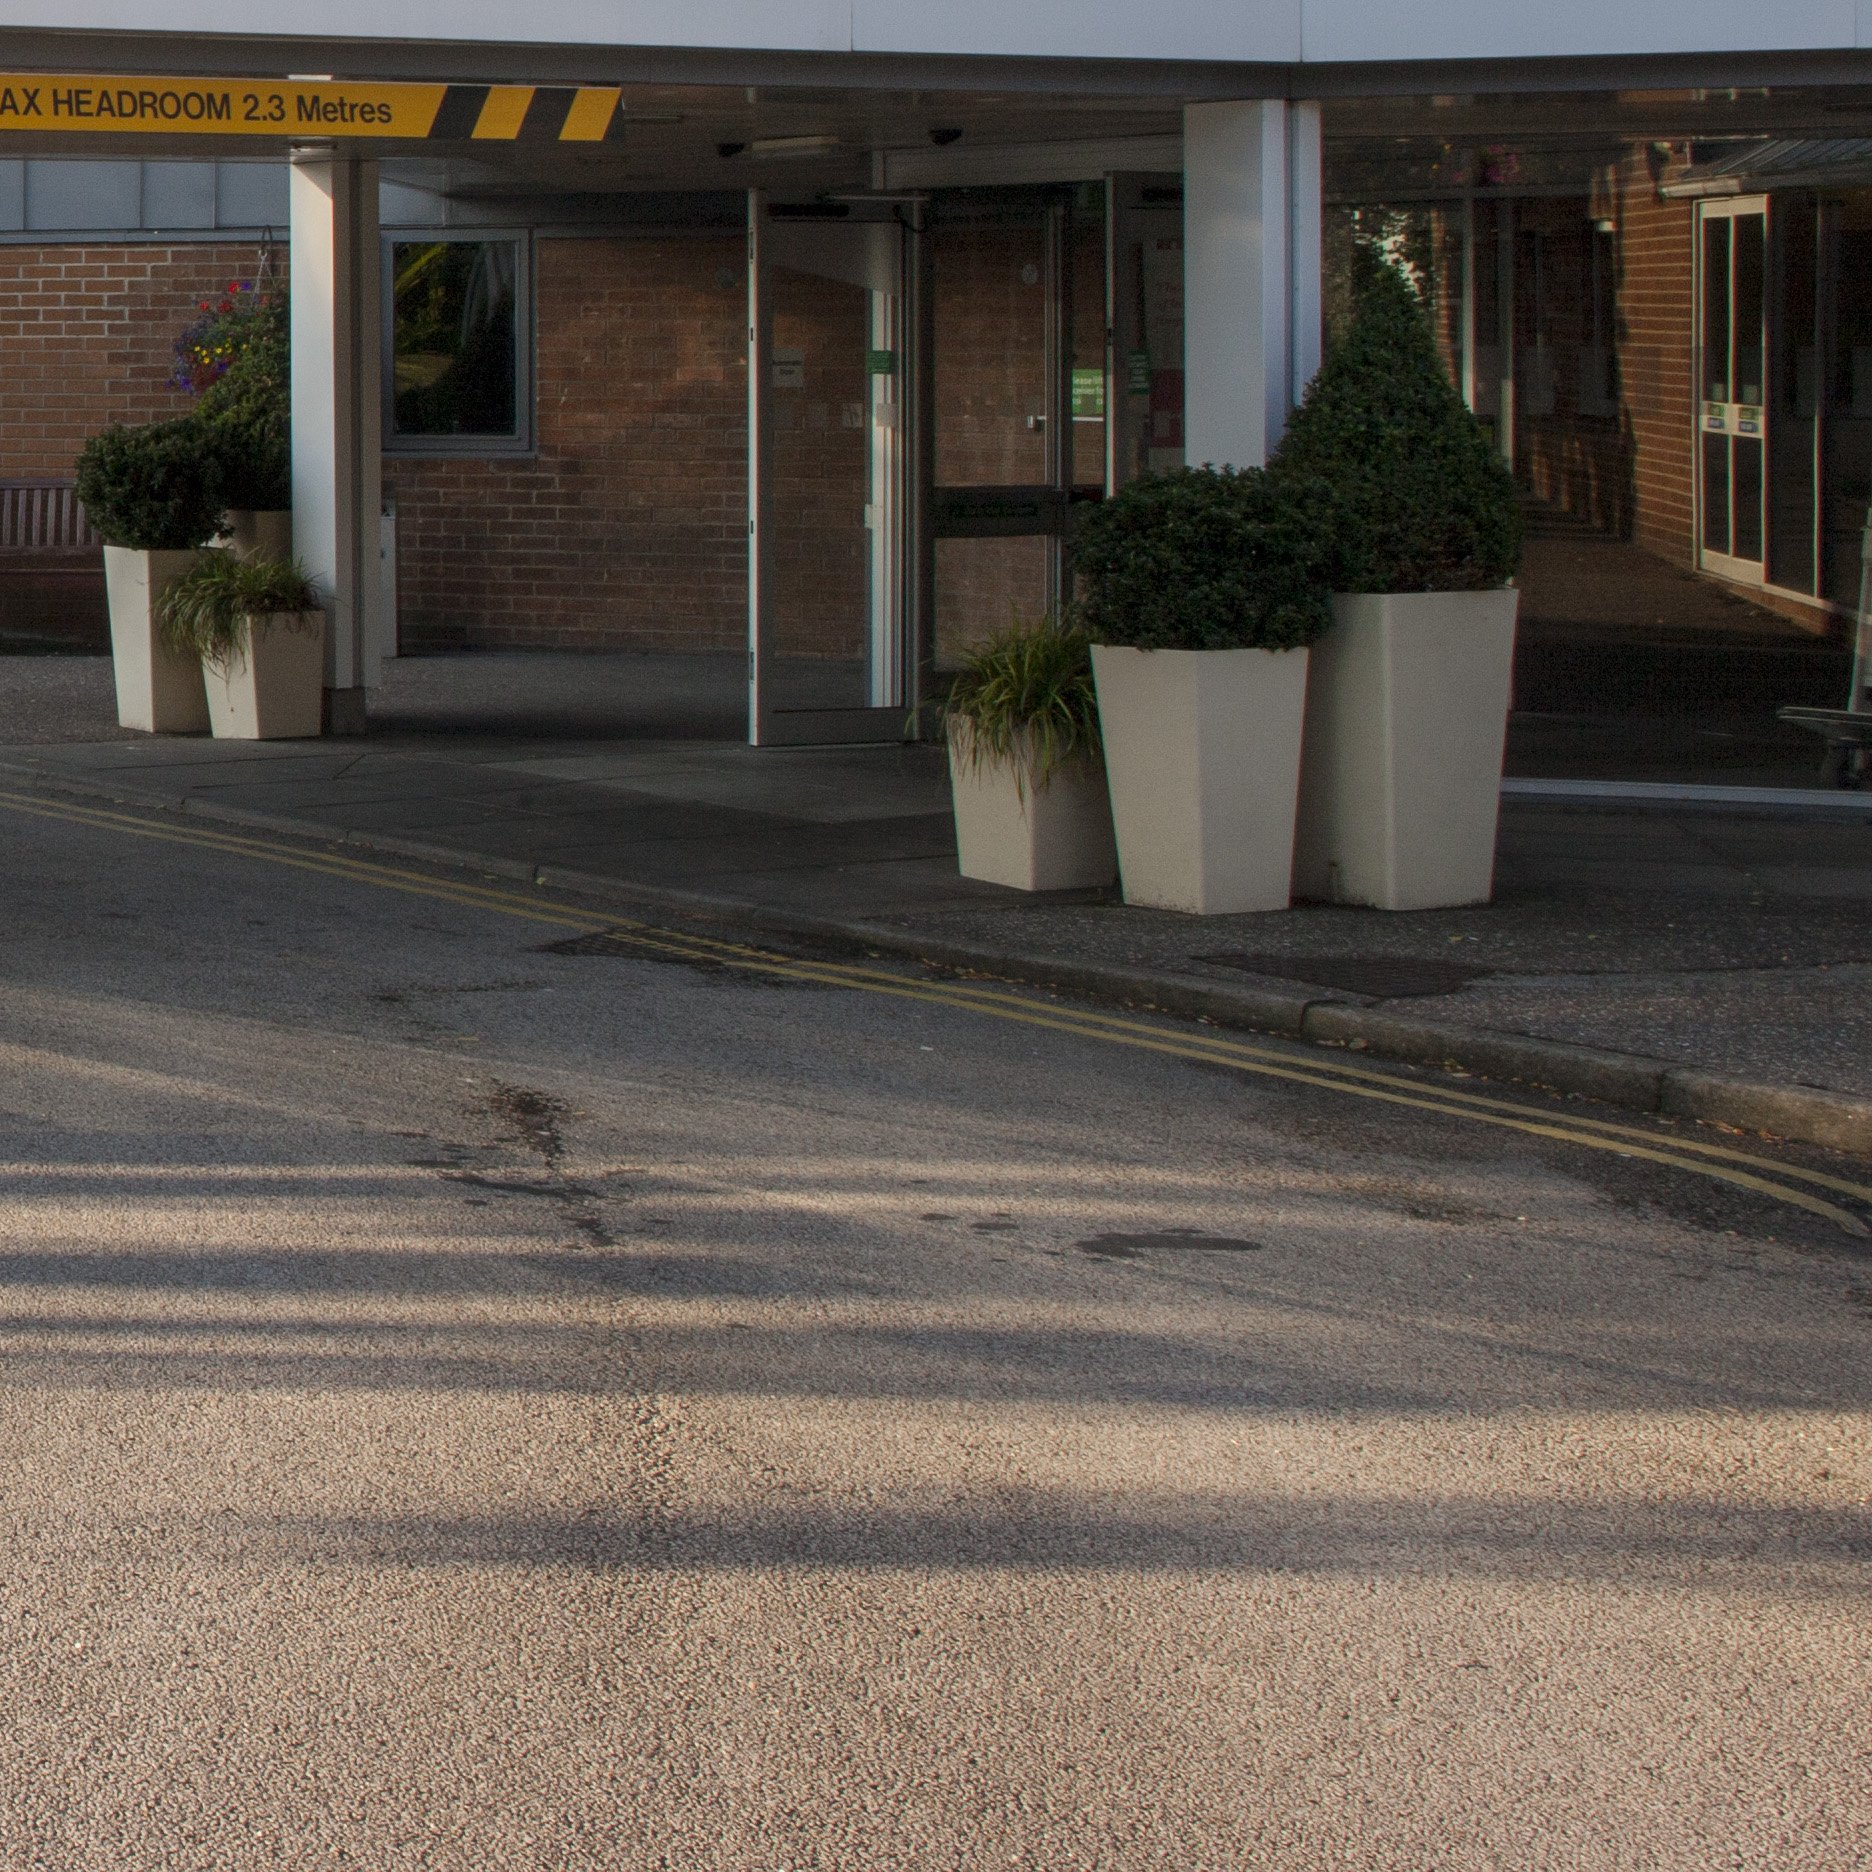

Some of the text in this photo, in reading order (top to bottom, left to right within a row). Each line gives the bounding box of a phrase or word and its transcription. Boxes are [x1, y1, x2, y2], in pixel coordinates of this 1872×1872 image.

[53, 88, 232, 120] HEADROOM
[242, 94, 285, 122] 2.3
[297, 95, 393, 124] Metres
